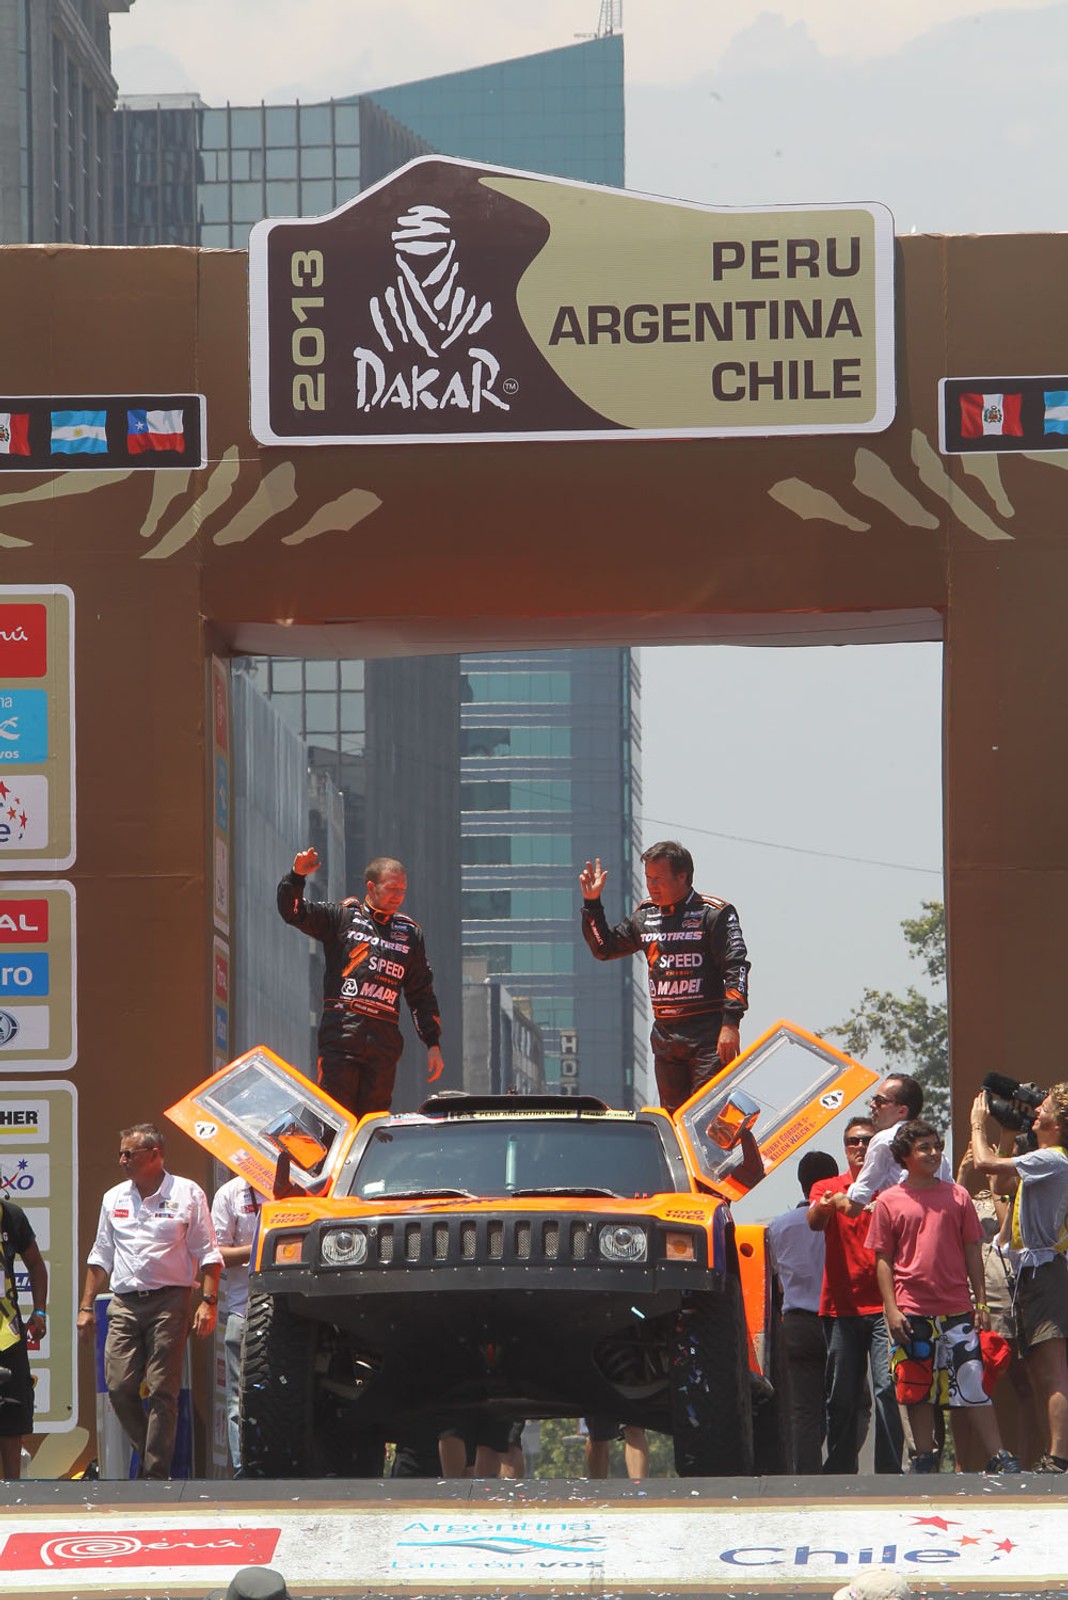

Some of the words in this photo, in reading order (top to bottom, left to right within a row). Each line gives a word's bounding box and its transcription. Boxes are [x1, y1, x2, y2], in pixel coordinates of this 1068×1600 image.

[711, 236, 862, 282] PERU
[291, 249, 326, 411] 2013
[548, 297, 863, 346] ARGENTINA
[353, 346, 510, 413] DAKAR
[711, 358, 862, 402] CHILE
[368, 956, 405, 979] SPEED
[659, 953, 703, 968] SPEED
[1, 966, 33, 986] ro
[657, 978, 703, 996] MAPEI
[0, 1110, 38, 1126] HER
[402, 1522, 592, 1533] Argentina
[719, 1544, 962, 1566] Chile
